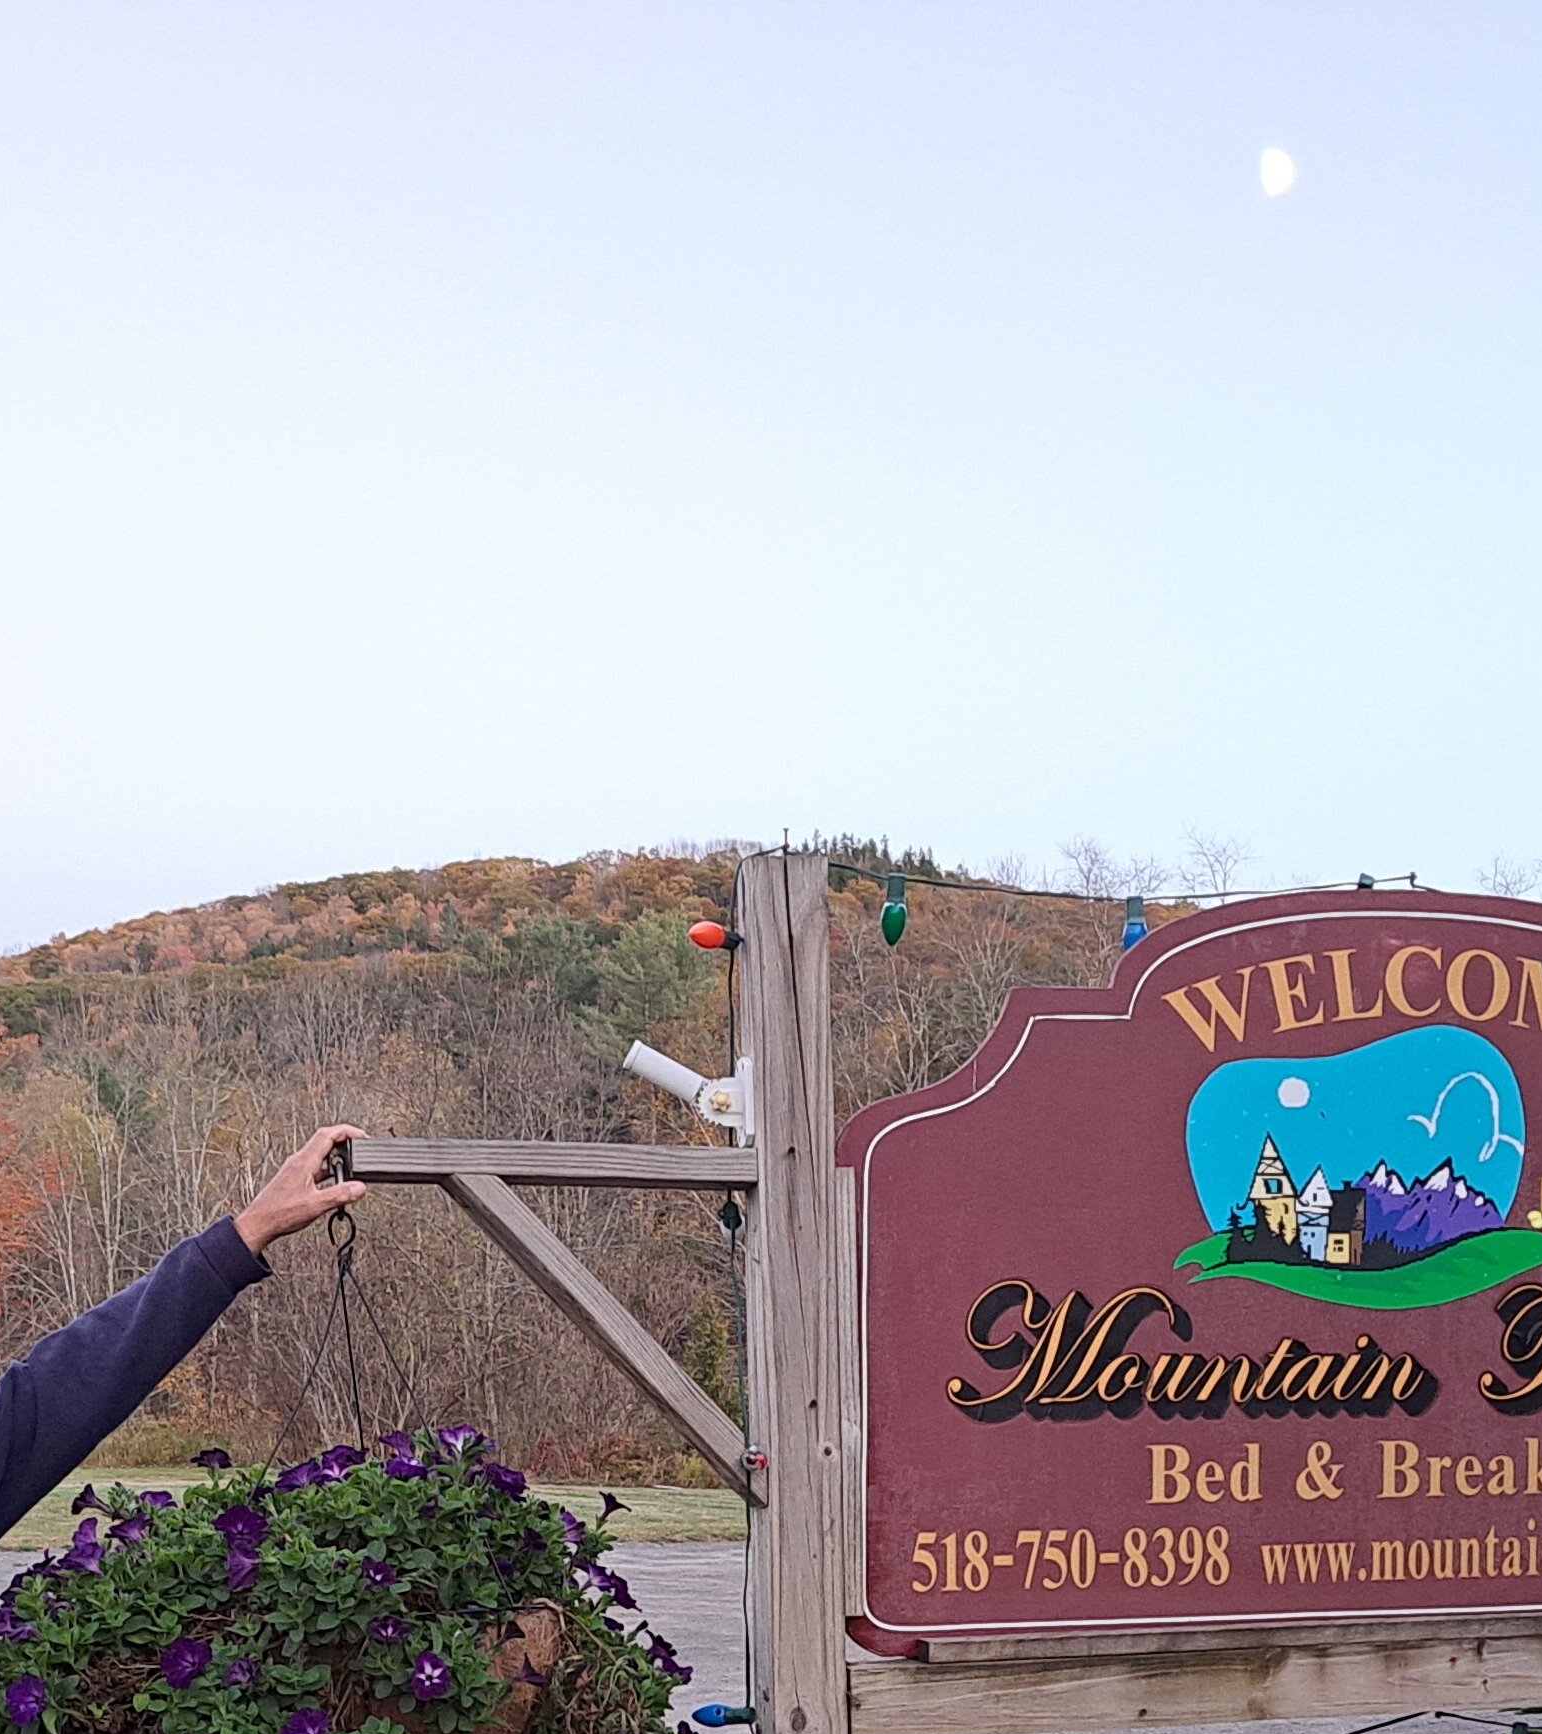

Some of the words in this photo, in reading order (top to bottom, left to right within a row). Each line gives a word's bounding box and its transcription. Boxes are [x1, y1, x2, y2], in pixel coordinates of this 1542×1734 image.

[946, 1279, 1425, 1407] Mountain
[1145, 1441, 1263, 1505] Bed
[1294, 1440, 1345, 1500] &
[910, 1525, 1231, 1594] 518-750-8398
